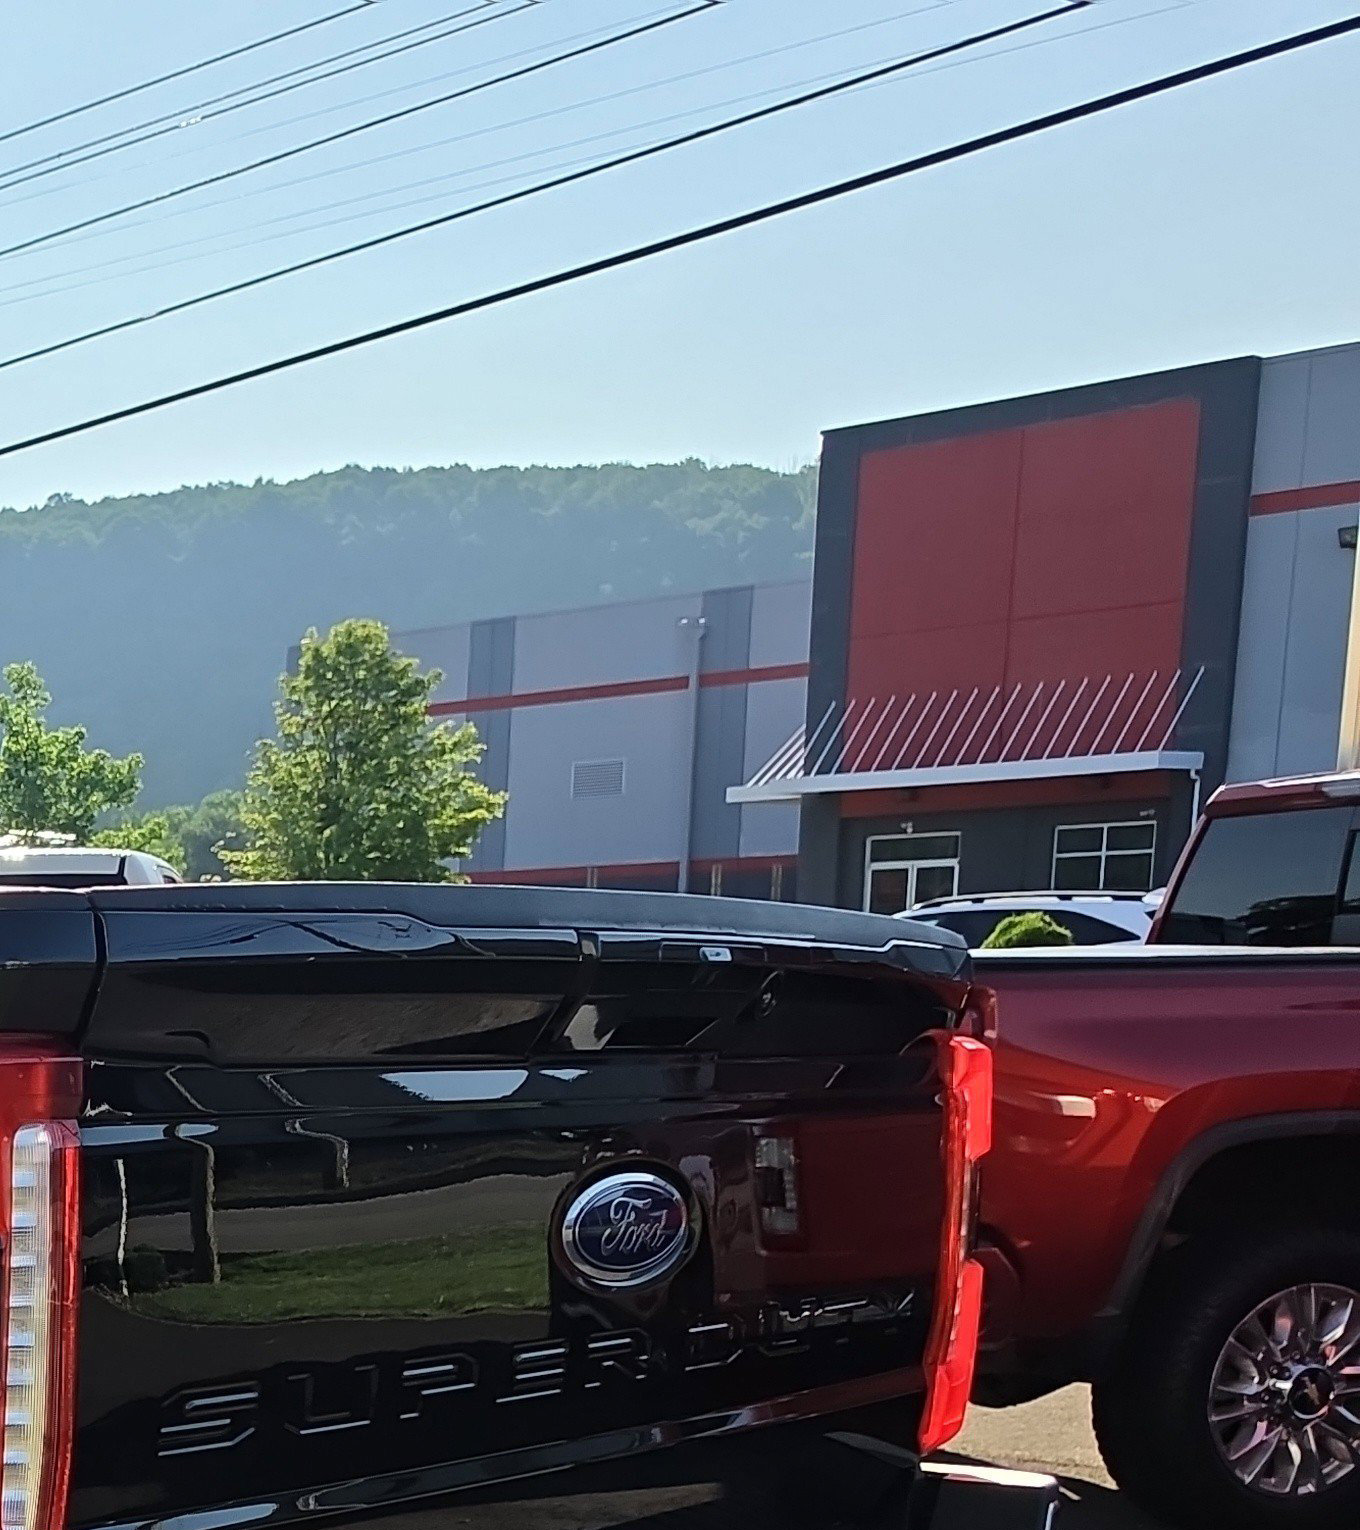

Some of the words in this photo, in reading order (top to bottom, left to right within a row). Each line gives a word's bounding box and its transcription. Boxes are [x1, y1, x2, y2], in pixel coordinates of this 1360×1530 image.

[601, 1197, 669, 1256] Ford
[157, 1329, 653, 1457] SUPER
[683, 1289, 917, 1373] DUTY
